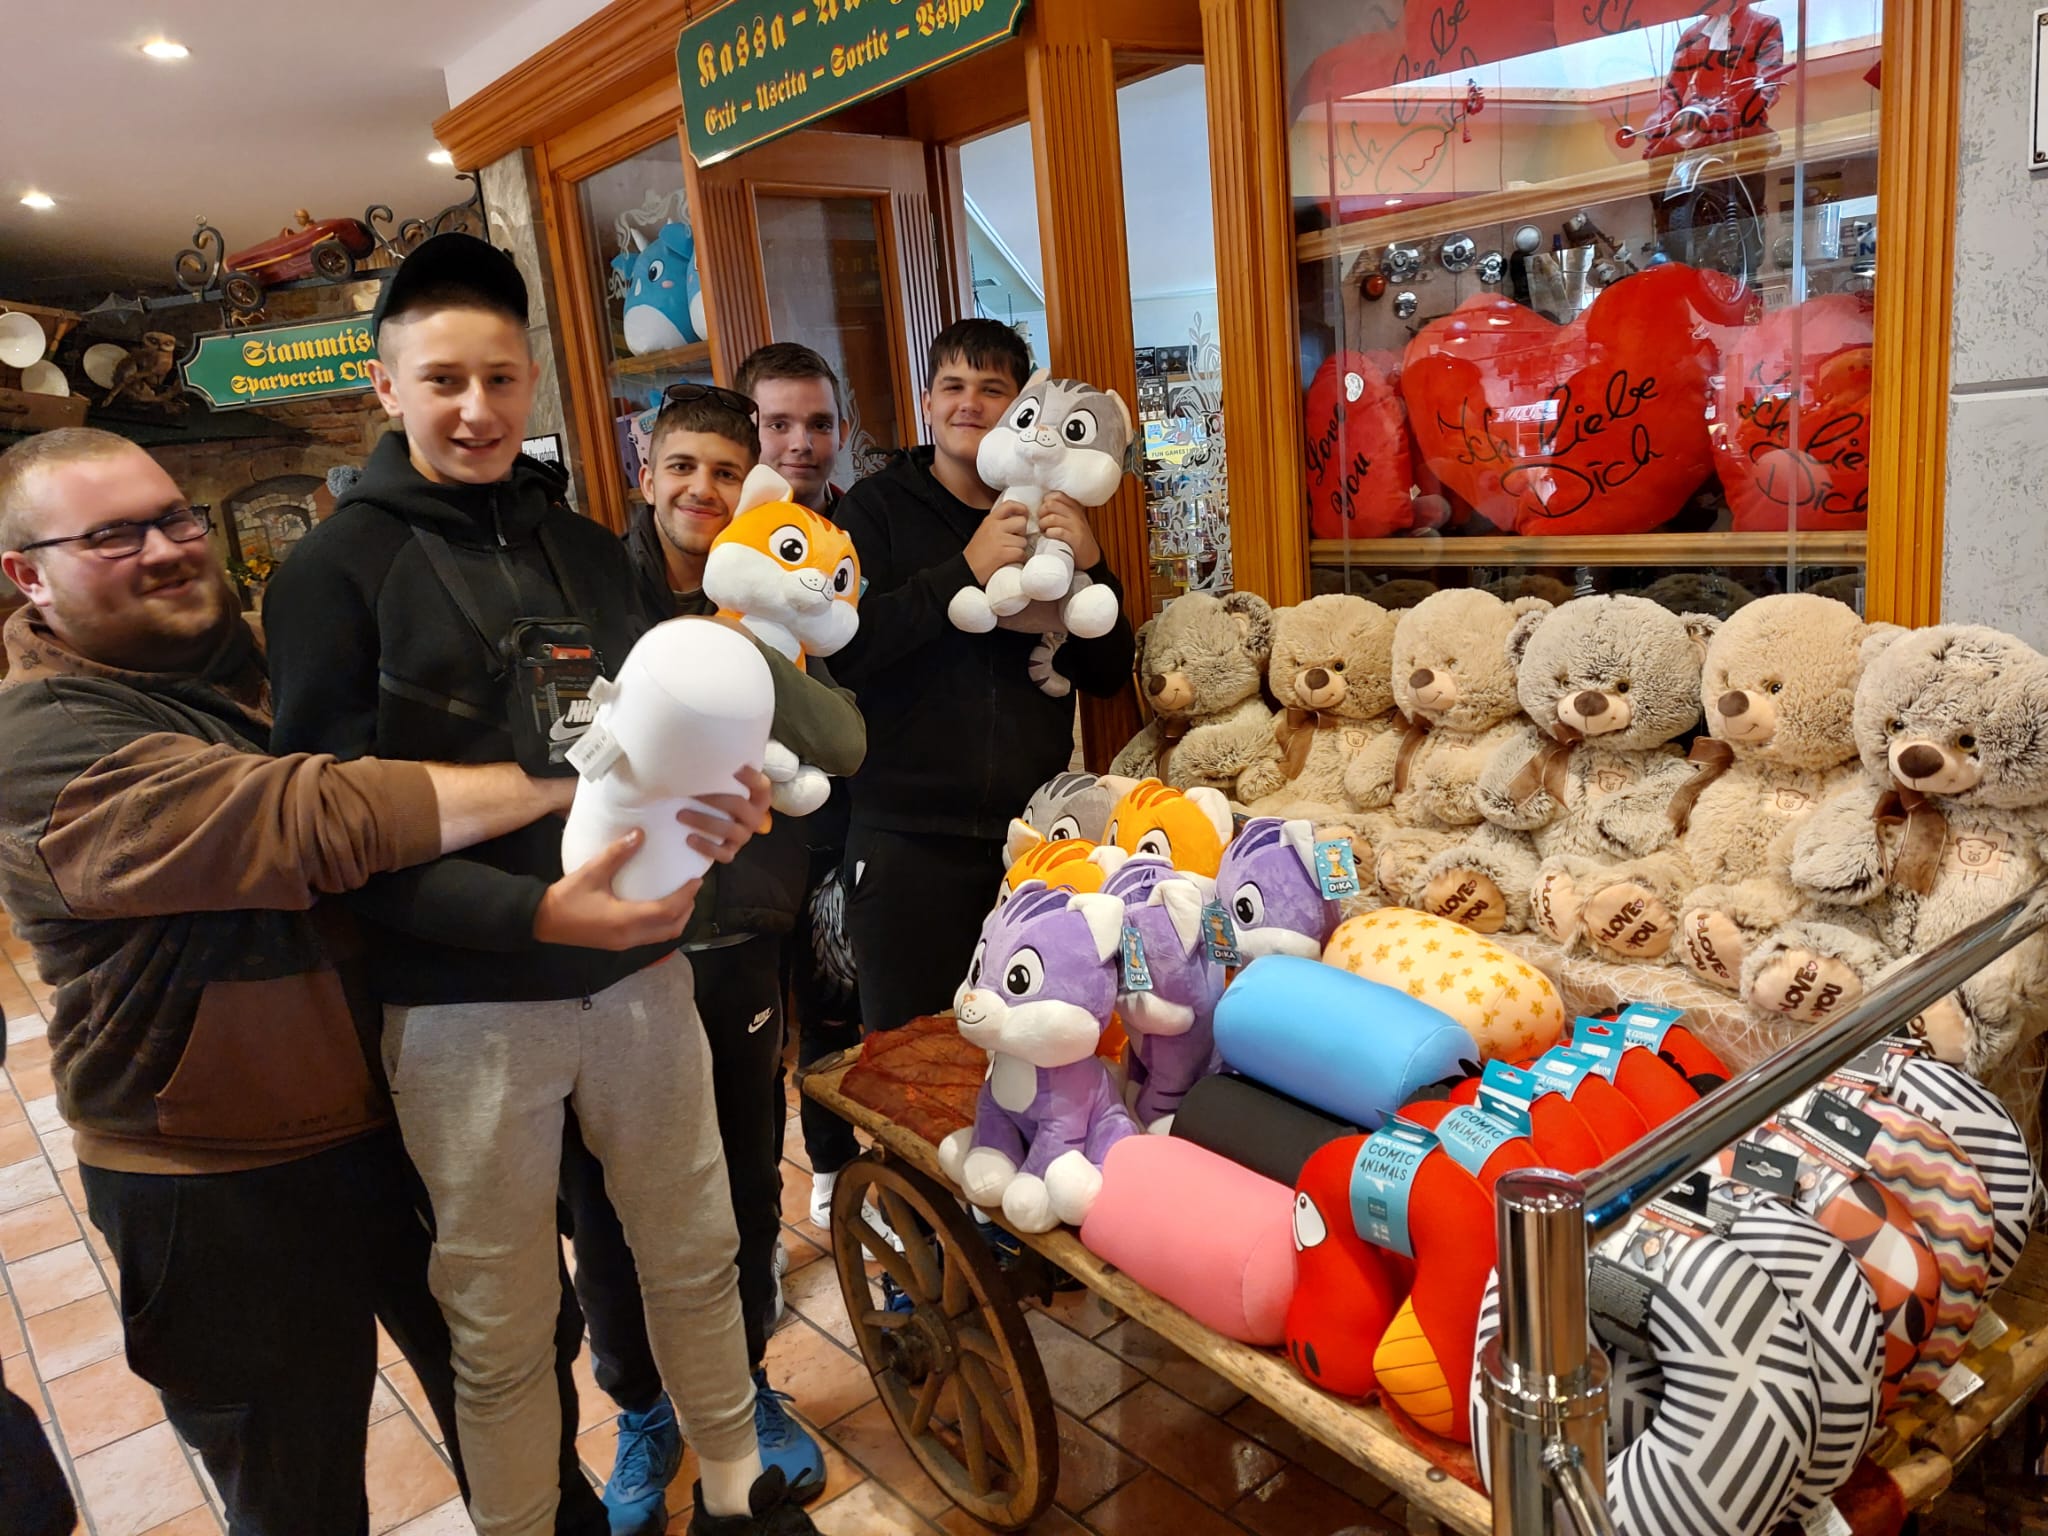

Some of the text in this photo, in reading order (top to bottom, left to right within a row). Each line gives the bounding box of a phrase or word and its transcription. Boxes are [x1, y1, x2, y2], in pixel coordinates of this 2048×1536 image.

[697, 15, 786, 87] Kassa
[704, 101, 737, 136] Exit
[756, 72, 807, 112] Uscita
[830, 28, 889, 77] Sortie
[242, 327, 375, 367] Stammtis
[231, 366, 335, 397] Sparverein
[1540, 370, 1658, 456] liebe
[1805, 413, 1869, 471] lie
[1501, 424, 1663, 518] Dich
[1438, 882, 1476, 915] LOVE
[1460, 899, 1489, 922] YOU
[1602, 902, 1642, 939] LOVE
[1625, 921, 1659, 948] YOU
[1686, 935, 1708, 971] YOU
[1697, 928, 1728, 974] LOVE
[1778, 966, 1818, 1010] LOVE
[1810, 983, 1843, 1013] YOU
[1448, 1118, 1492, 1150] ANIMALS
[1460, 1110, 1504, 1140] COMIC
[1360, 1158, 1408, 1181] ANIMALS
[1369, 1143, 1416, 1166] COMIC
